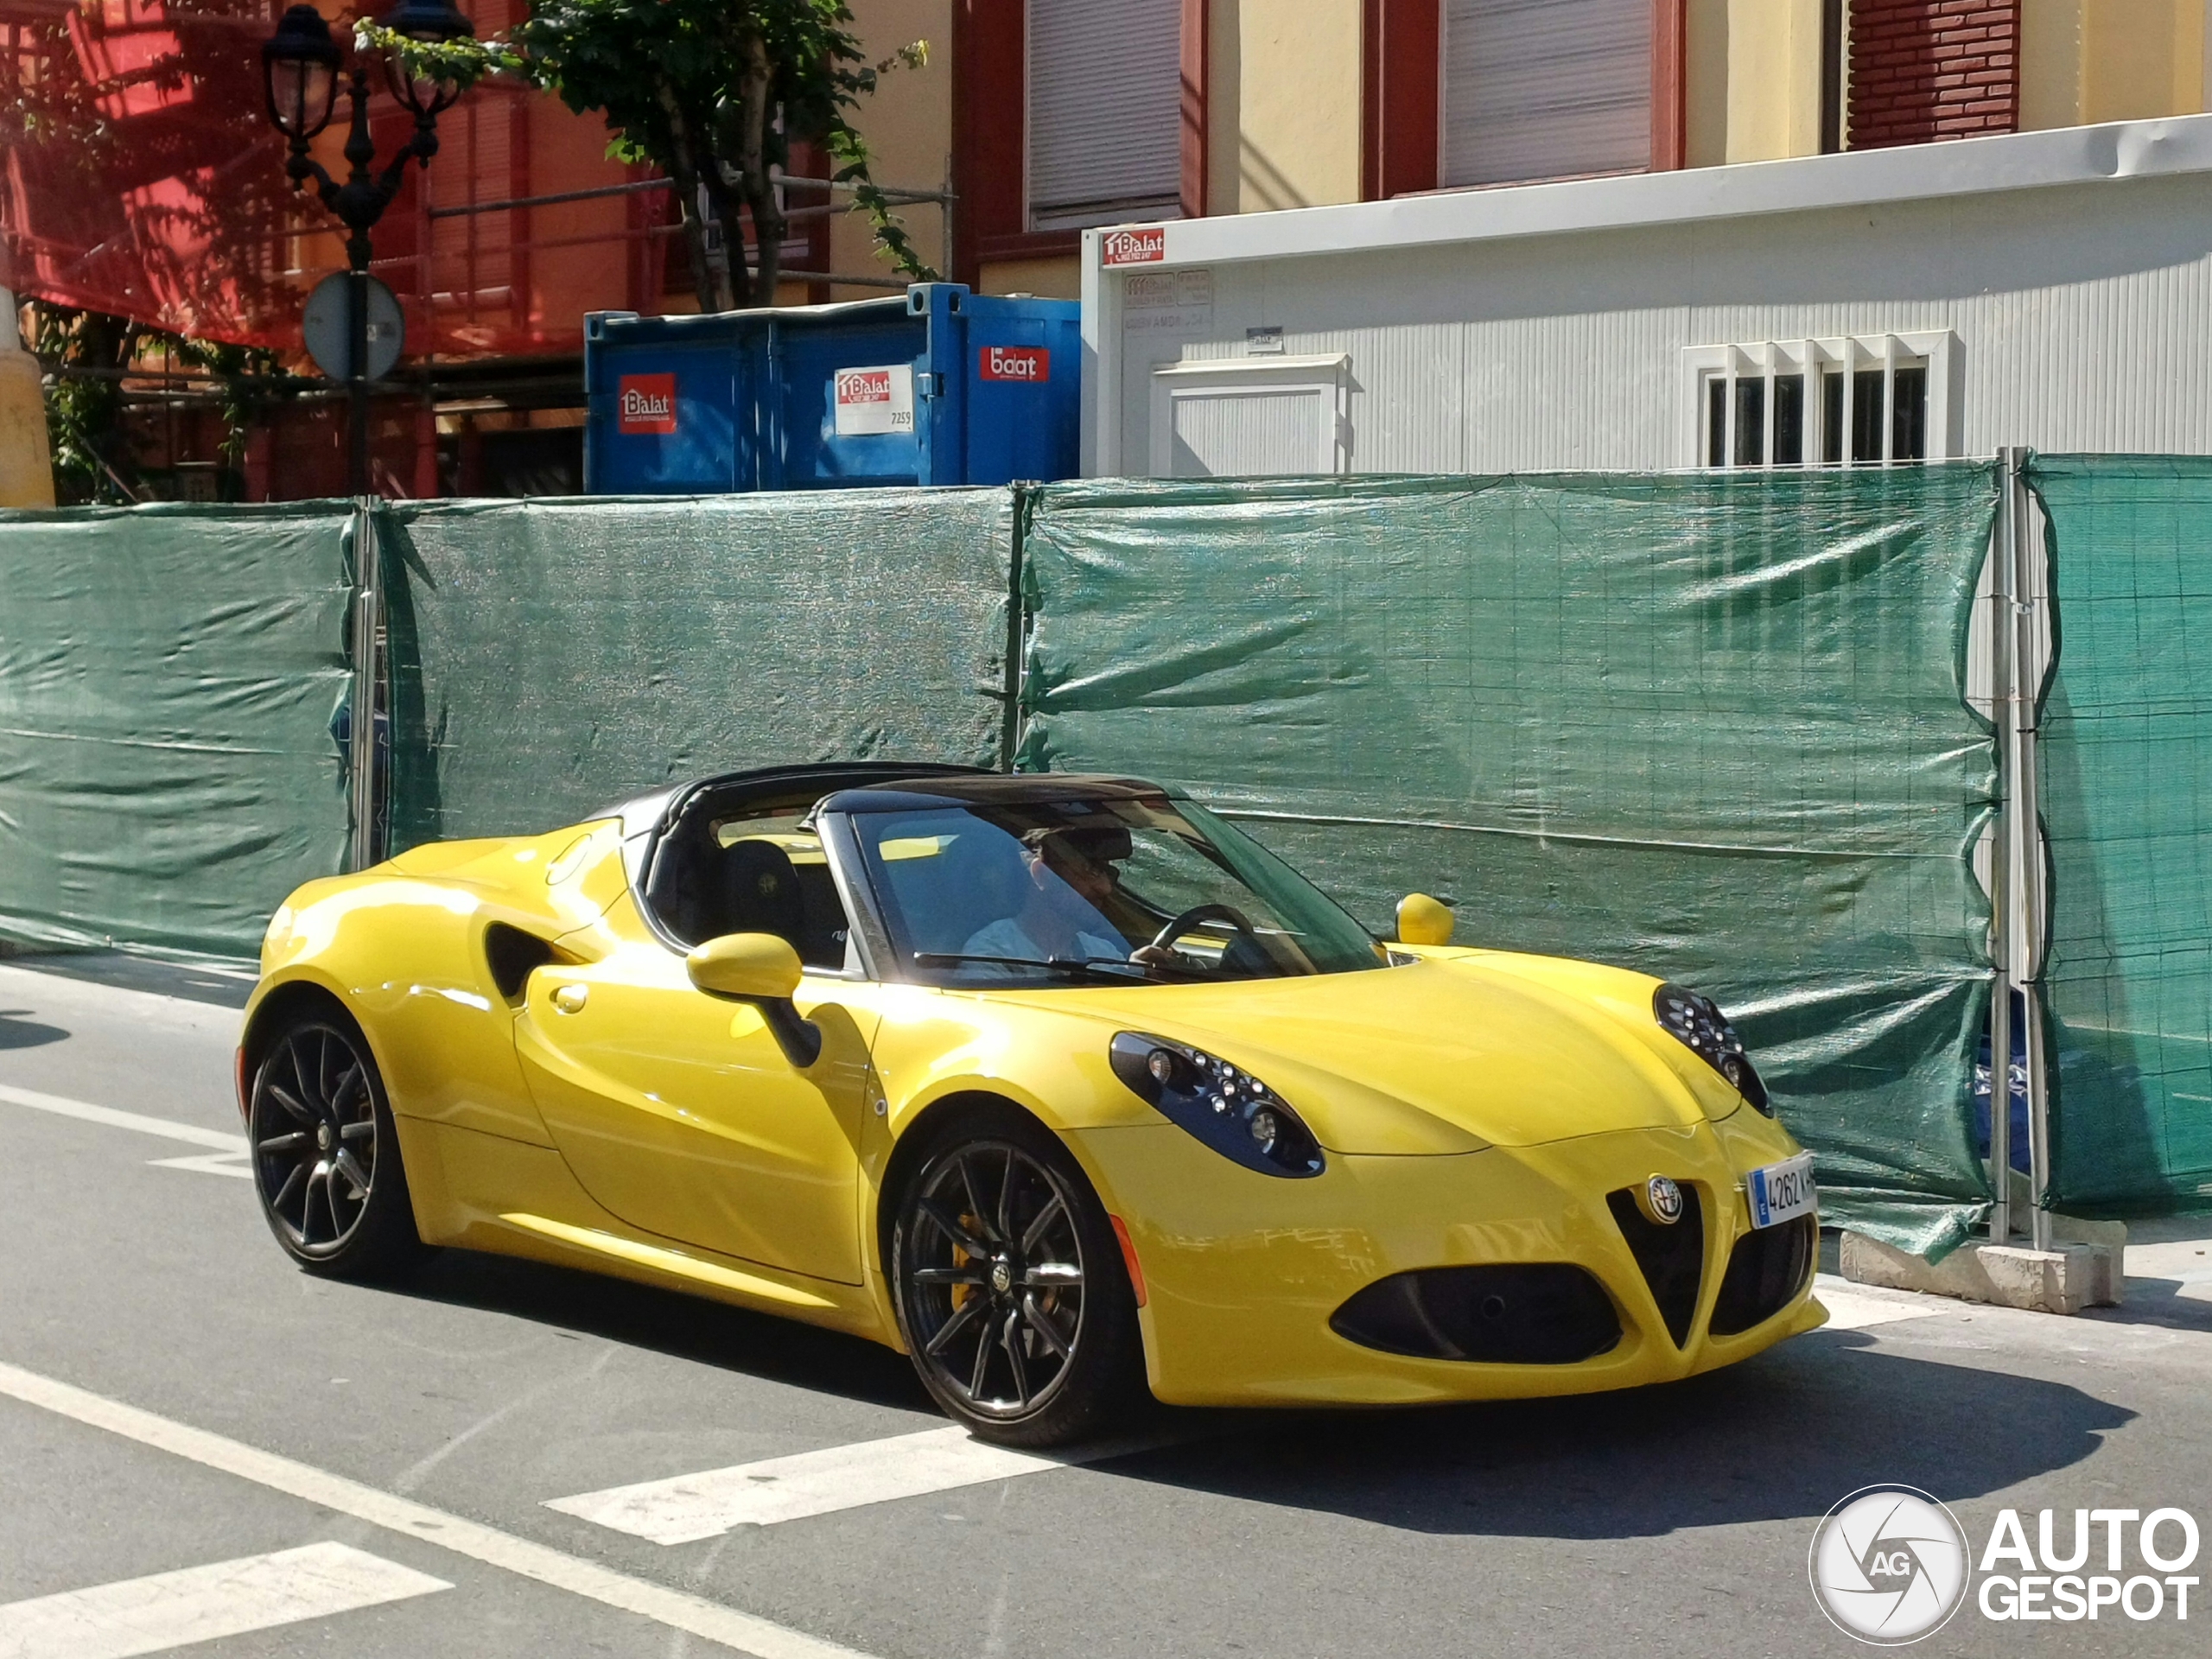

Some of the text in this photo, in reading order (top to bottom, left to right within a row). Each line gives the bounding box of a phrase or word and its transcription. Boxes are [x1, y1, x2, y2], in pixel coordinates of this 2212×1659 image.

[1116, 232, 1163, 253] Balat
[849, 375, 890, 395] Balat
[622, 389, 669, 415] Balat
[891, 412, 911, 425] 7259
[1769, 1172, 1800, 1211] 4262
